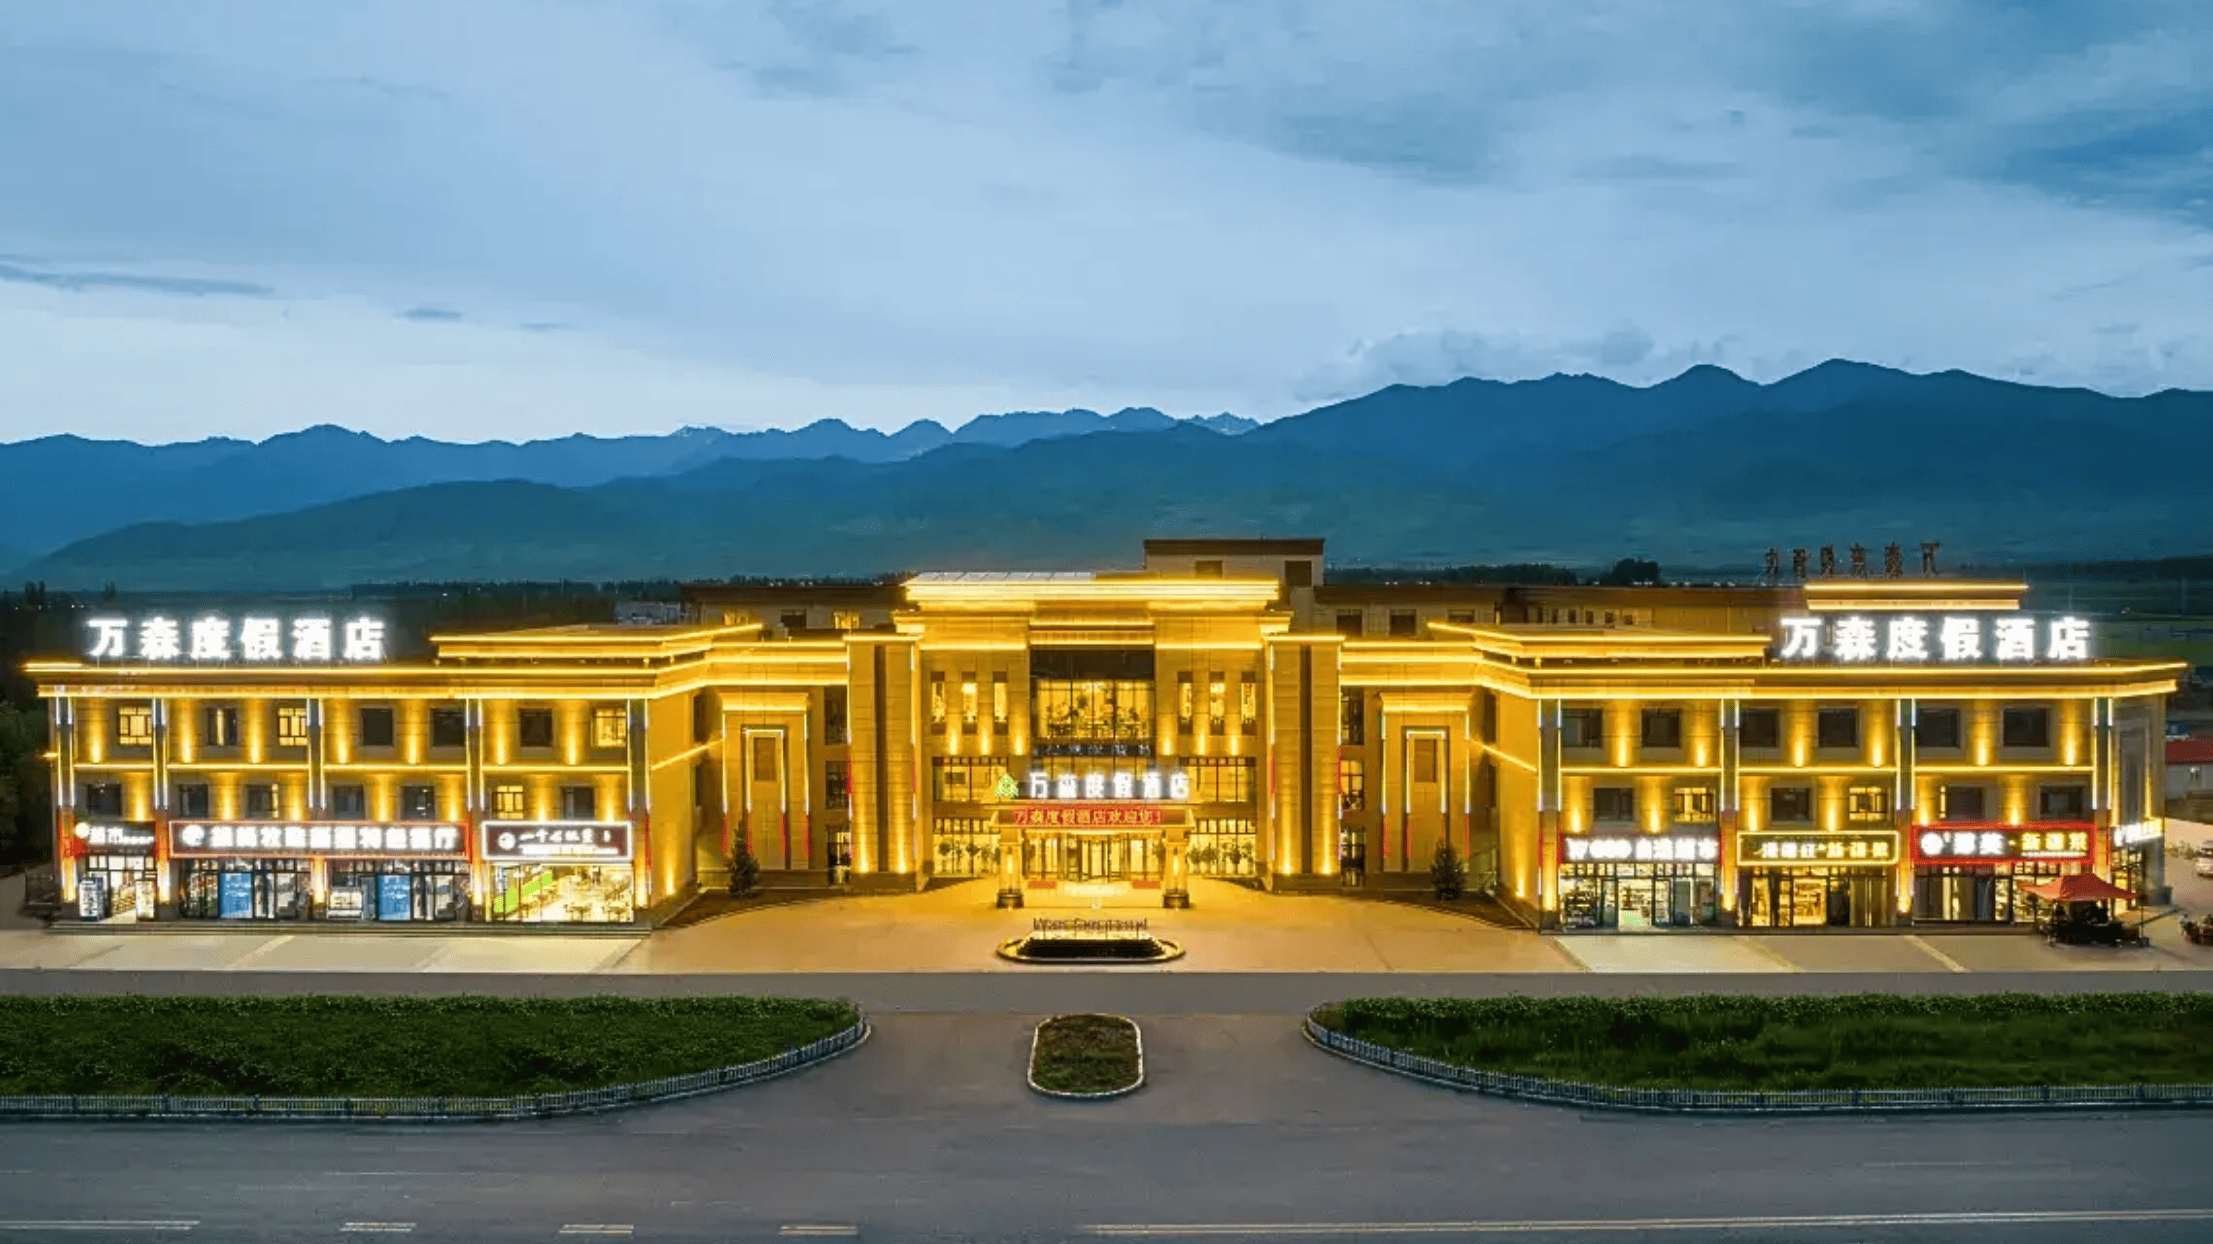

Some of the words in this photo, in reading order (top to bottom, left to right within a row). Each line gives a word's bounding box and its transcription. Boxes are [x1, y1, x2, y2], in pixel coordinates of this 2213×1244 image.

[86, 616, 385, 660] 万森度假酒店
[1780, 616, 2090, 660] 万森度假酒店
